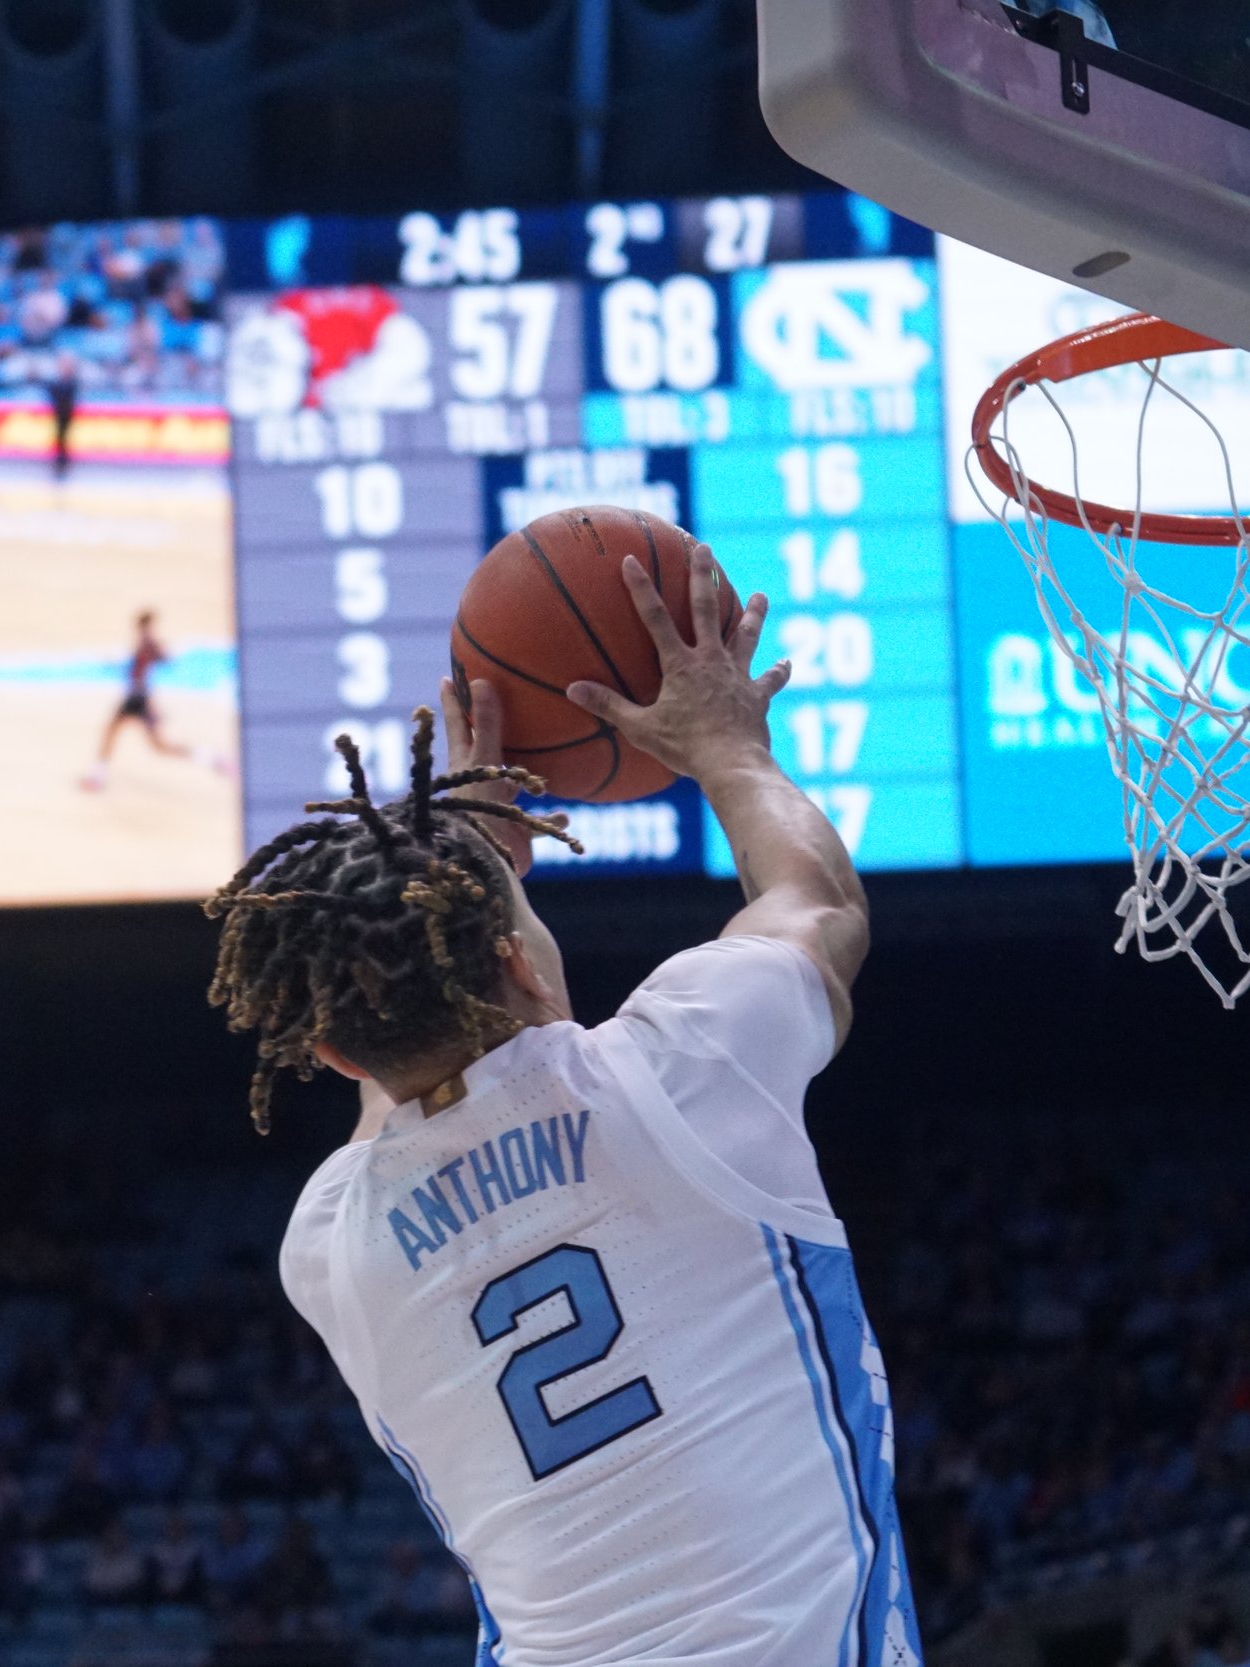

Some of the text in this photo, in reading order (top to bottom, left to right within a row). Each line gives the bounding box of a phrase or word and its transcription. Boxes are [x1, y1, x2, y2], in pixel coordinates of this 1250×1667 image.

[400, 210, 520, 285] 2:45
[450, 284, 557, 400] 57
[601, 275, 718, 392] 68
[316, 463, 403, 536] 10
[775, 442, 864, 517] 16
[335, 549, 389, 622] 5
[780, 528, 866, 602] 14
[337, 634, 390, 707] 3
[778, 612, 873, 688] 20
[788, 700, 869, 775] 17
[387, 1110, 590, 1271] ANTHONY
[470, 1242, 663, 1482] 2
